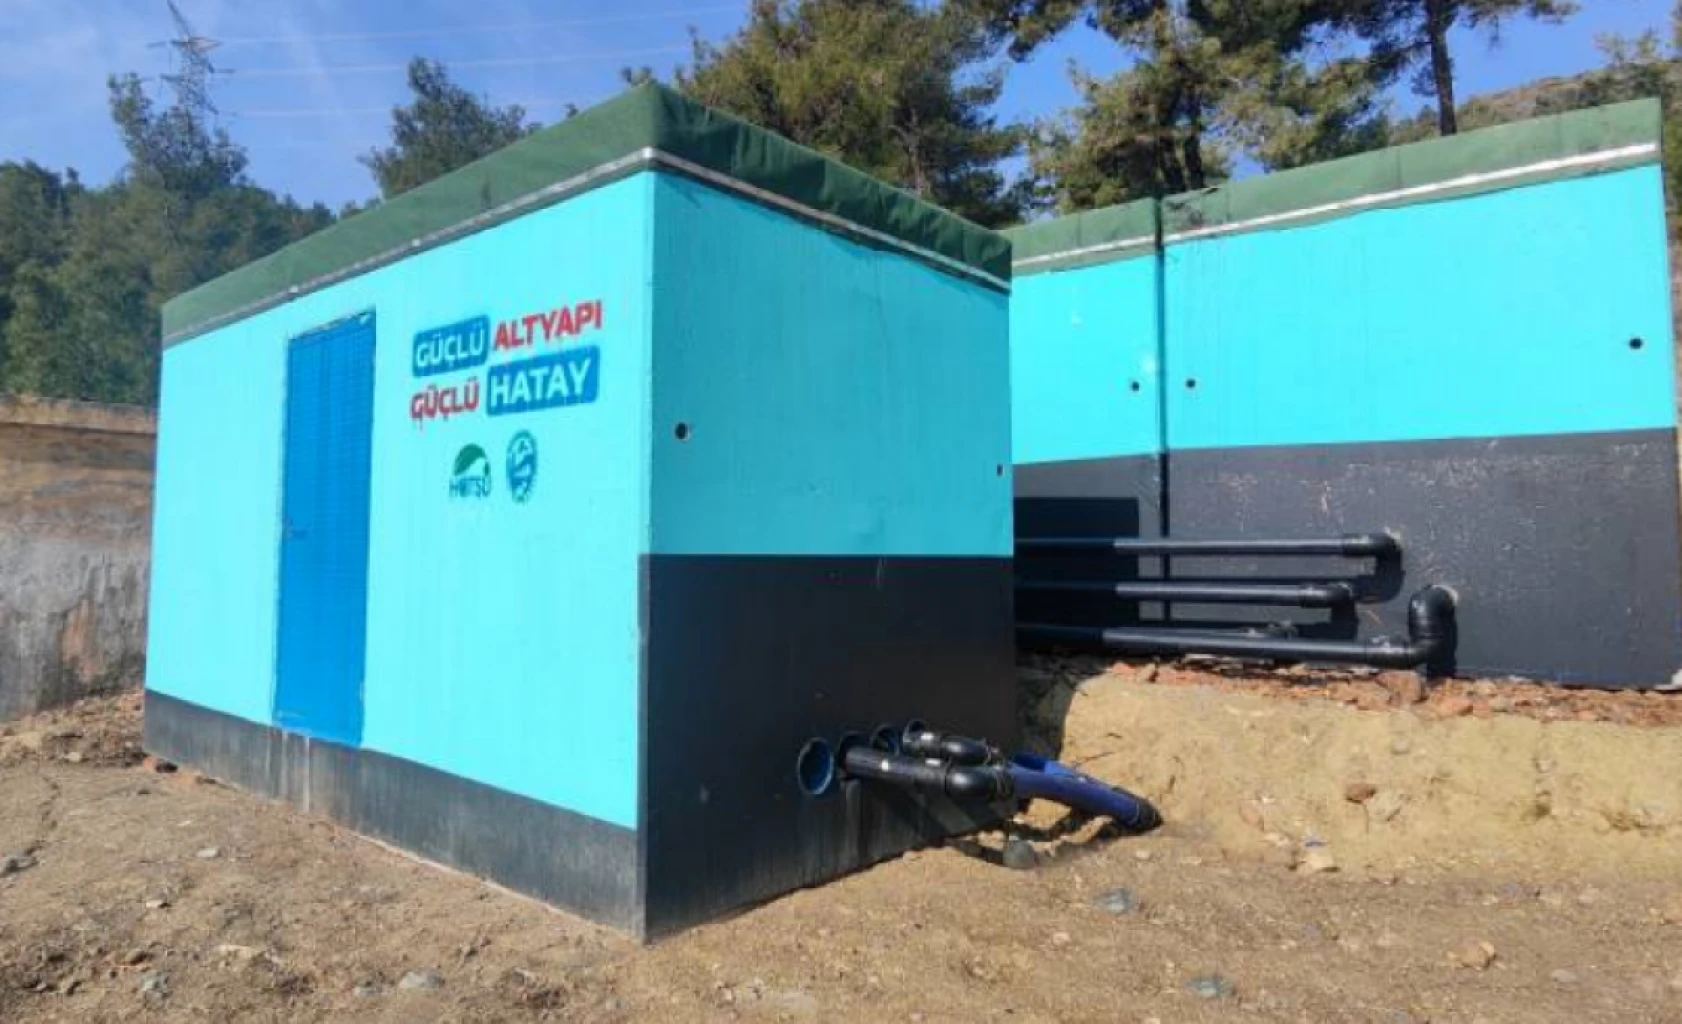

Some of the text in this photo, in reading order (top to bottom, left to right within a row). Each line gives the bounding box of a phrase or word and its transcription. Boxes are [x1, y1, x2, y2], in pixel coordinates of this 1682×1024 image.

[416, 300, 602, 368] GÜÇLÜ ALTYAPI
[410, 358, 591, 421] GÜÇLÜ HATAY
